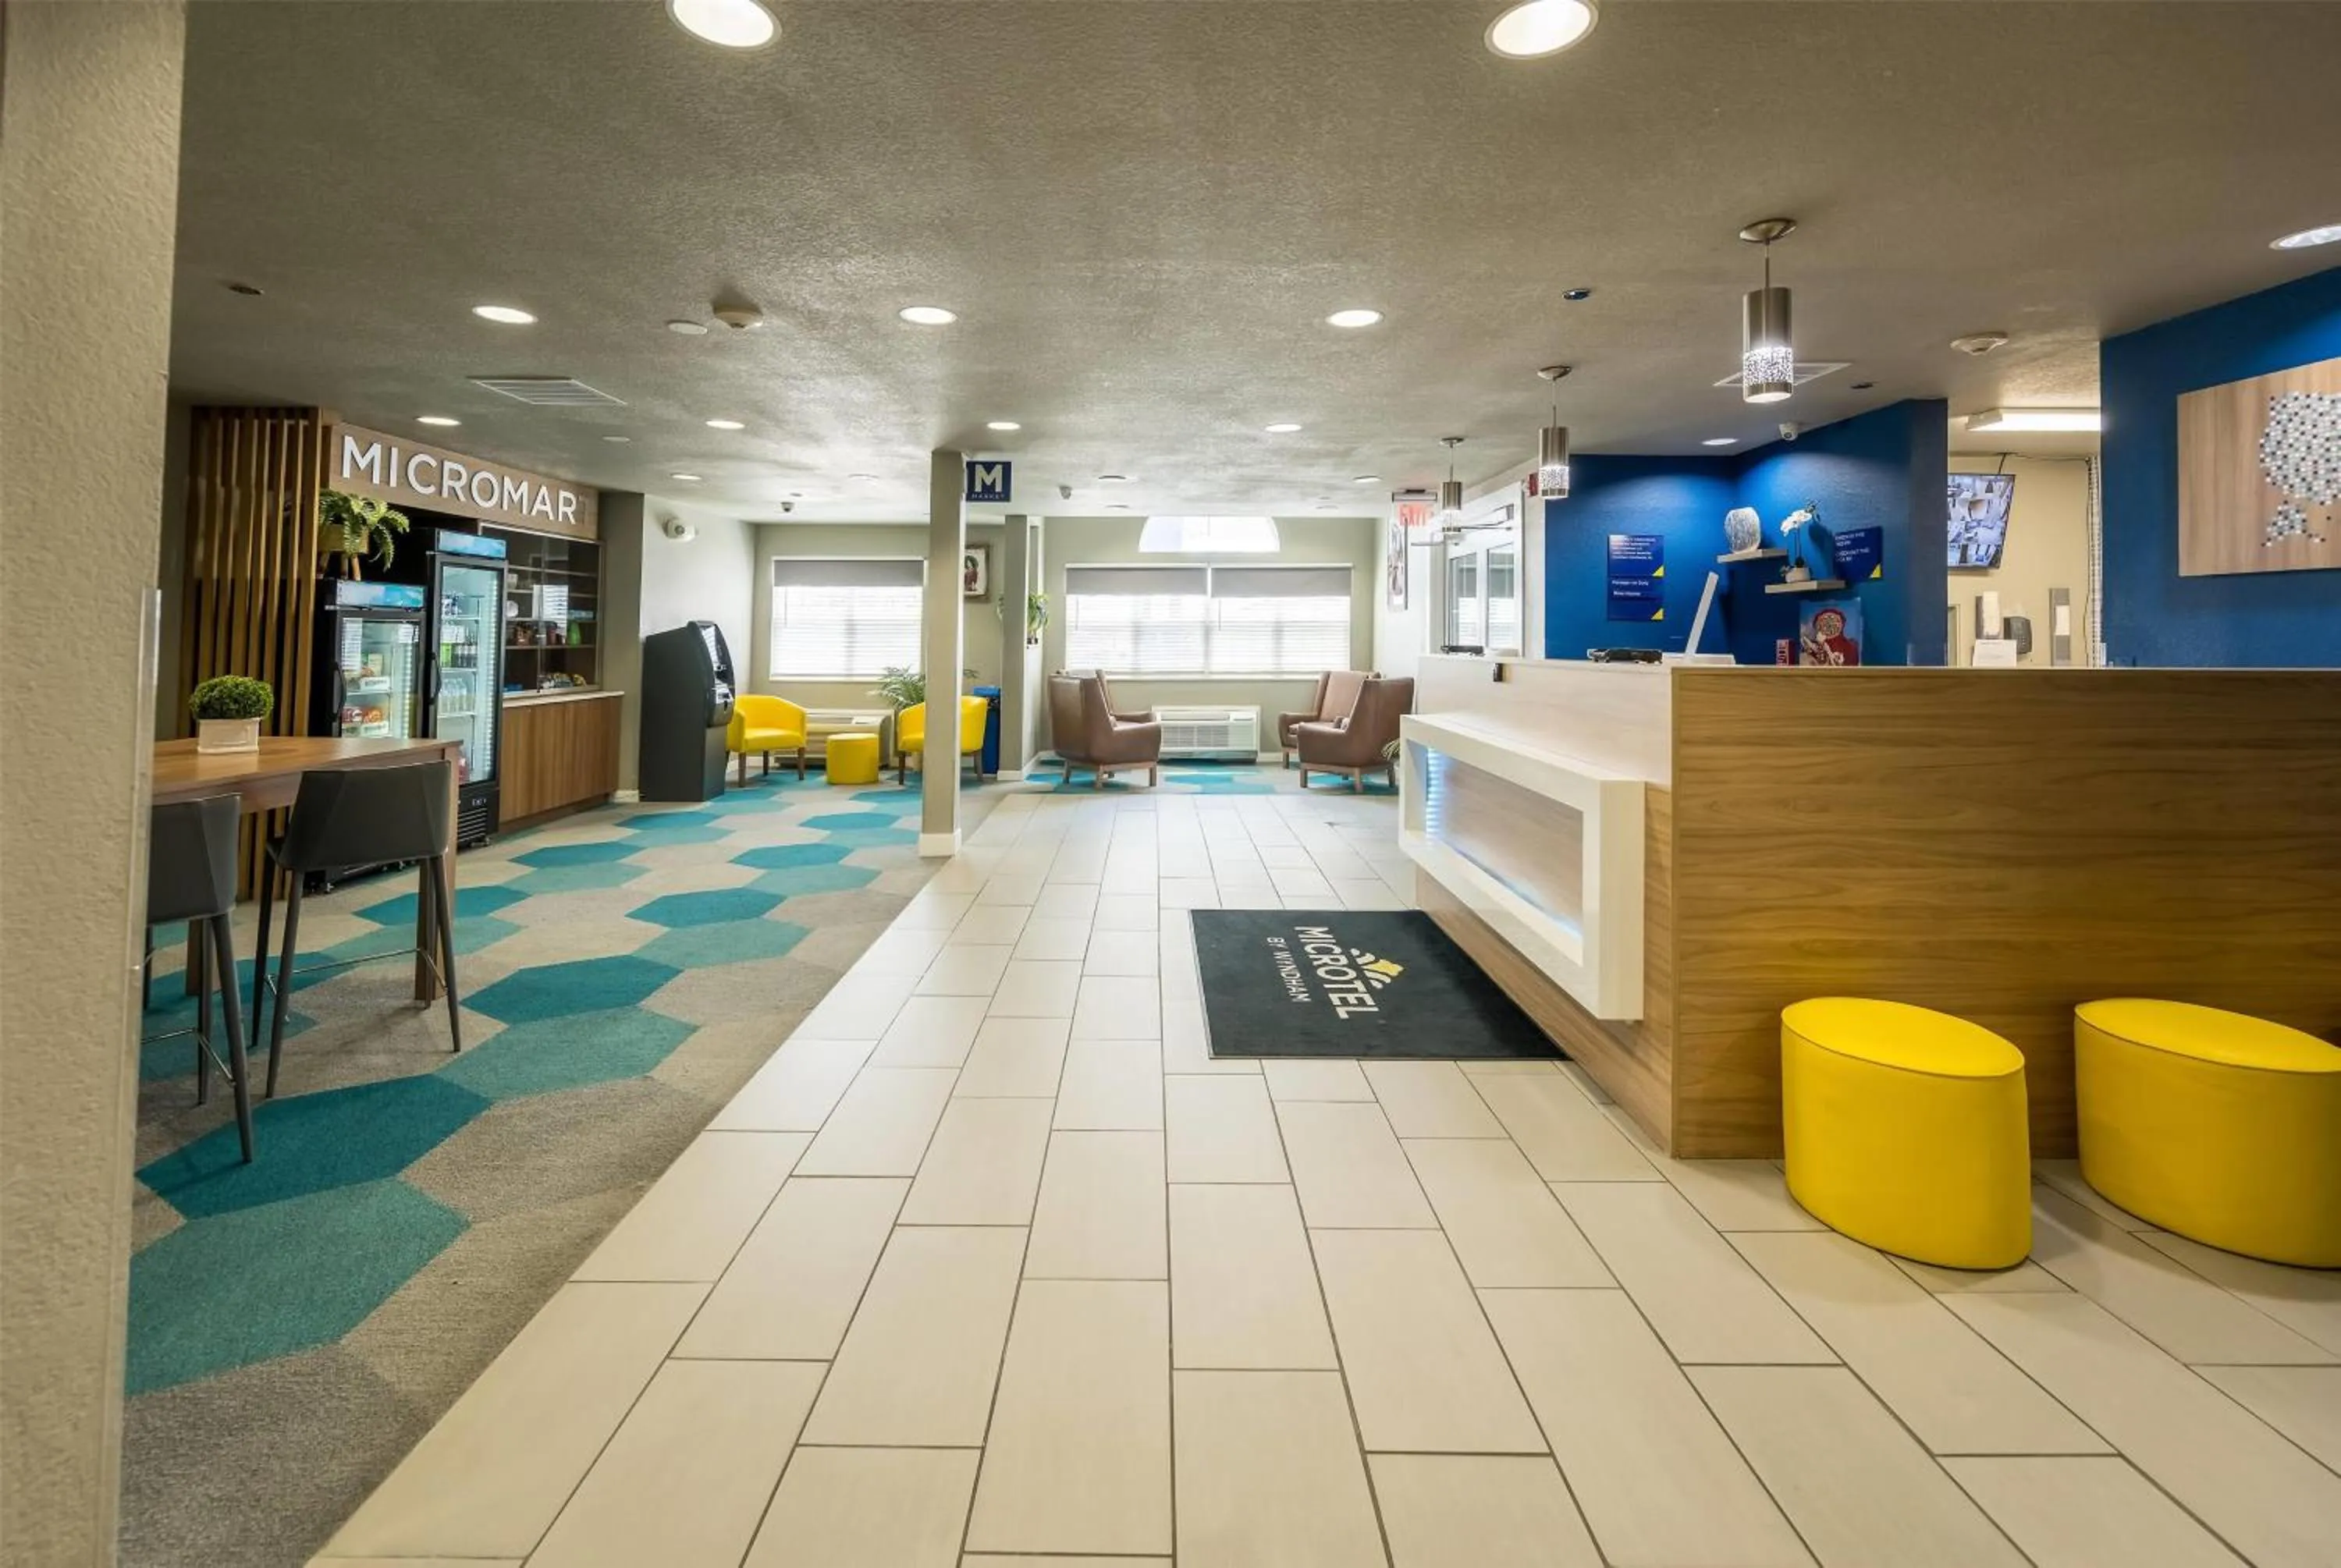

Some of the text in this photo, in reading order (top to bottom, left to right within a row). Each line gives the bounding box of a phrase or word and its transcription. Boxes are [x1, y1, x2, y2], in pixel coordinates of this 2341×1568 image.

[974, 463, 1003, 492] M
[1266, 936, 1287, 949] BY
[1294, 926, 1380, 1020] MICROTEL
